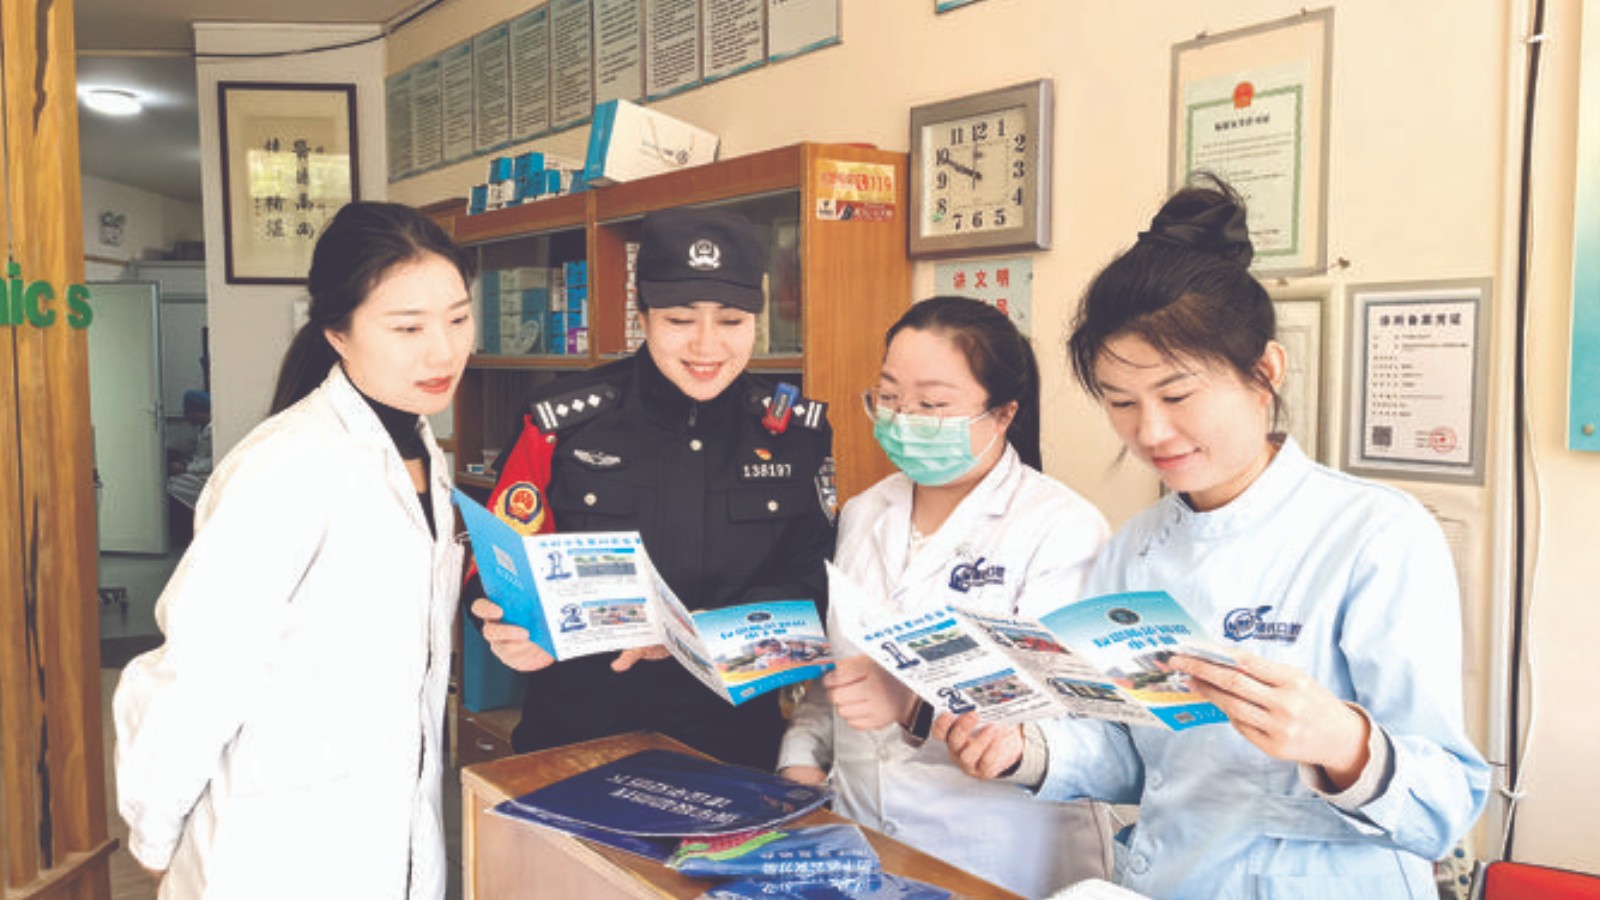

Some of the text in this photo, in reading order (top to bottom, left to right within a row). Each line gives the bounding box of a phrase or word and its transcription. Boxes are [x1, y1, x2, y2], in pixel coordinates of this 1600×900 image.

[951, 128, 963, 145] 11
[972, 122, 988, 141] 12
[998, 119, 1005, 137] 1
[1013, 134, 1026, 152] 2
[936, 148, 950, 165] 10
[1013, 161, 1025, 179] 3
[936, 173, 947, 189] 9
[1012, 188, 1023, 205] 4
[937, 199, 947, 215] 8
[953, 213, 963, 230] 7
[972, 211, 983, 228] 6
[994, 208, 1006, 226] 5
[0, 262, 93, 329] ics
[545, 551, 572, 581] 1
[560, 603, 587, 633] 2
[881, 641, 920, 670] 1
[936, 687, 978, 715] 2
